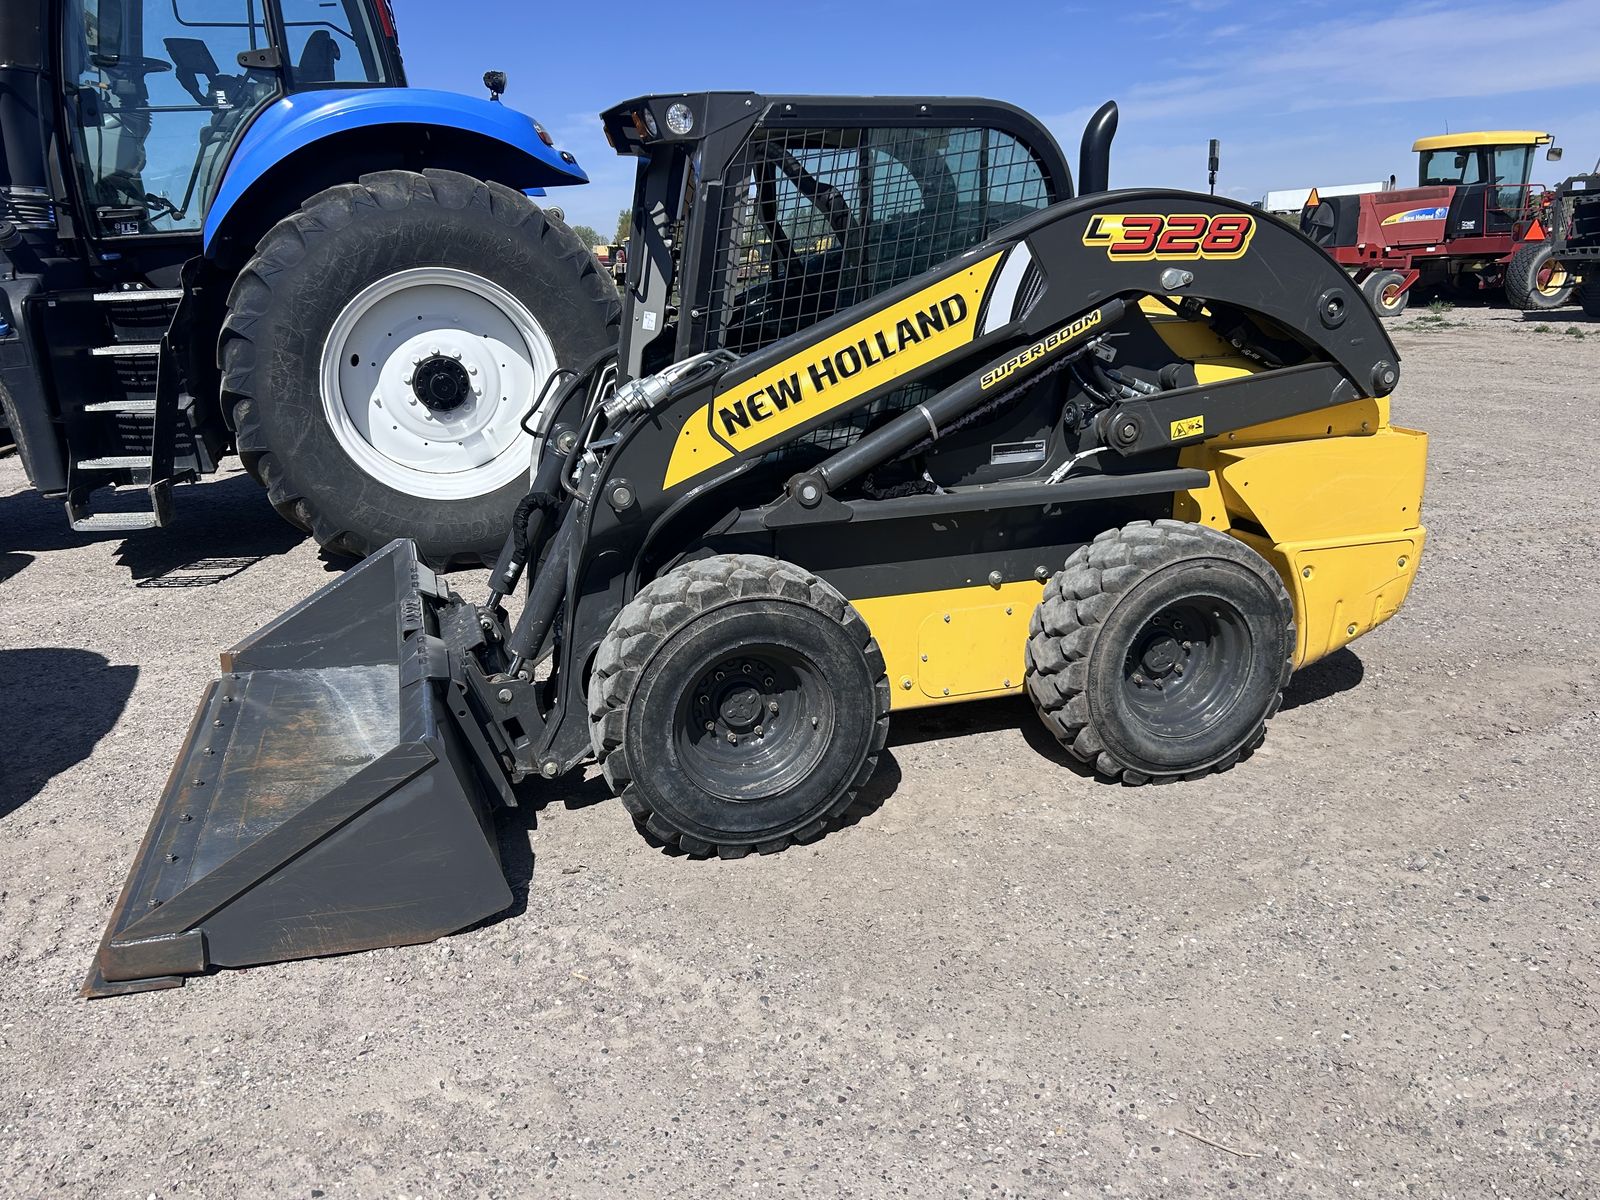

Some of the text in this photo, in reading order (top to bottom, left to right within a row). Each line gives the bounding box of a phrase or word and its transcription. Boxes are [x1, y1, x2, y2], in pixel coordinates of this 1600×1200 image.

[718, 293, 968, 436] NEW HOLLAND
[981, 309, 1101, 390] SUPER BOOM
